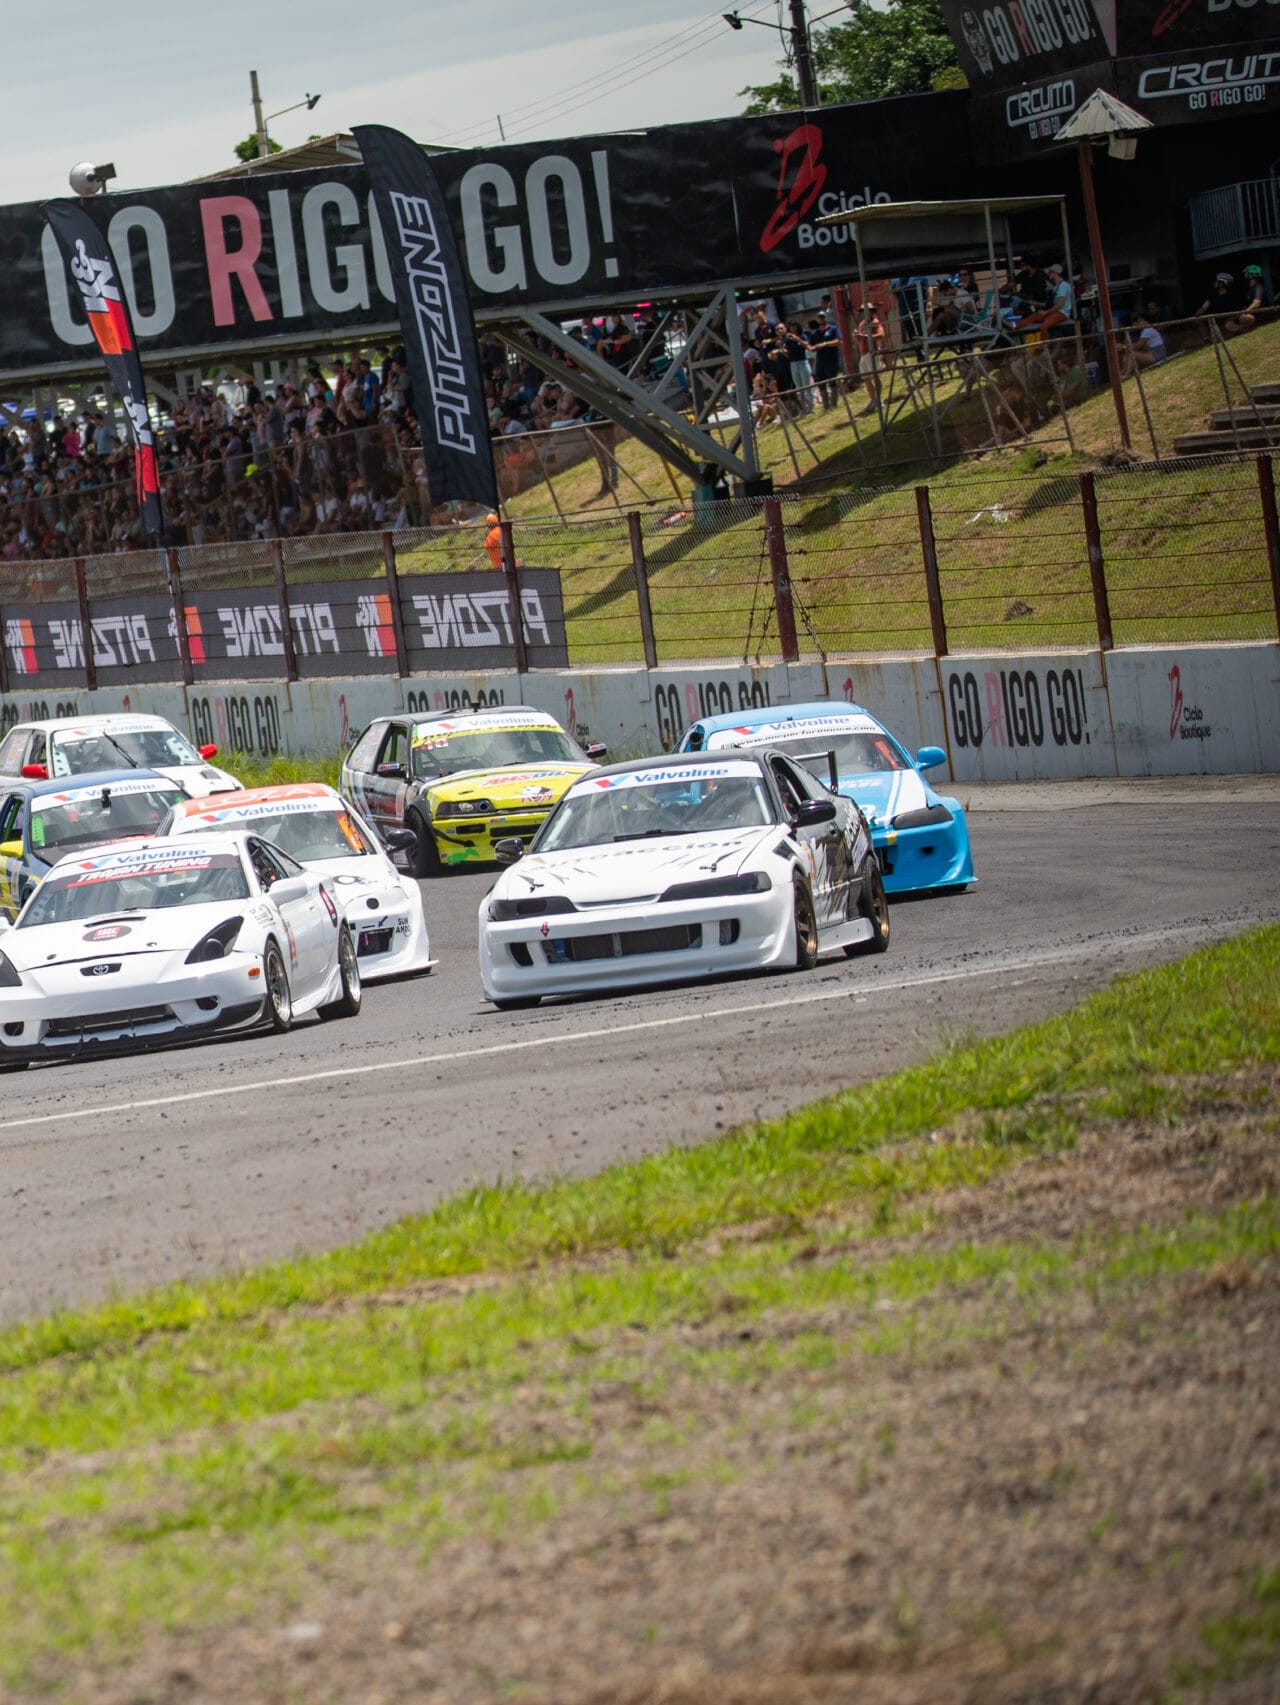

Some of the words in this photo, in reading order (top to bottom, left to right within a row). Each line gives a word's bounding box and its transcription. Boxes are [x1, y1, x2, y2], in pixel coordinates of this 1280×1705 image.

[983, 6, 1020, 64] GO
[1010, 0, 1063, 56] RIGO
[1189, 91, 1207, 110] GO
[1210, 87, 1241, 108] RIGO
[1244, 84, 1267, 103] GO!
[199, 182, 396, 326] RIG
[459, 150, 620, 293] GO!
[389, 191, 476, 456] PITZONE
[949, 671, 984, 748] GO
[984, 670, 1044, 748] RIGO
[1046, 668, 1090, 746] GO!
[97, 722, 154, 734] Valvoline
[468, 716, 535, 727] Valvoline
[769, 717, 850, 731] Valvoline
[481, 771, 569, 787] AMSOIL
[634, 766, 729, 783] Valvoline
[85, 783, 156, 797] Vavoline
[235, 802, 318, 817] Valvoline
[116, 849, 207, 864] Valvoline
